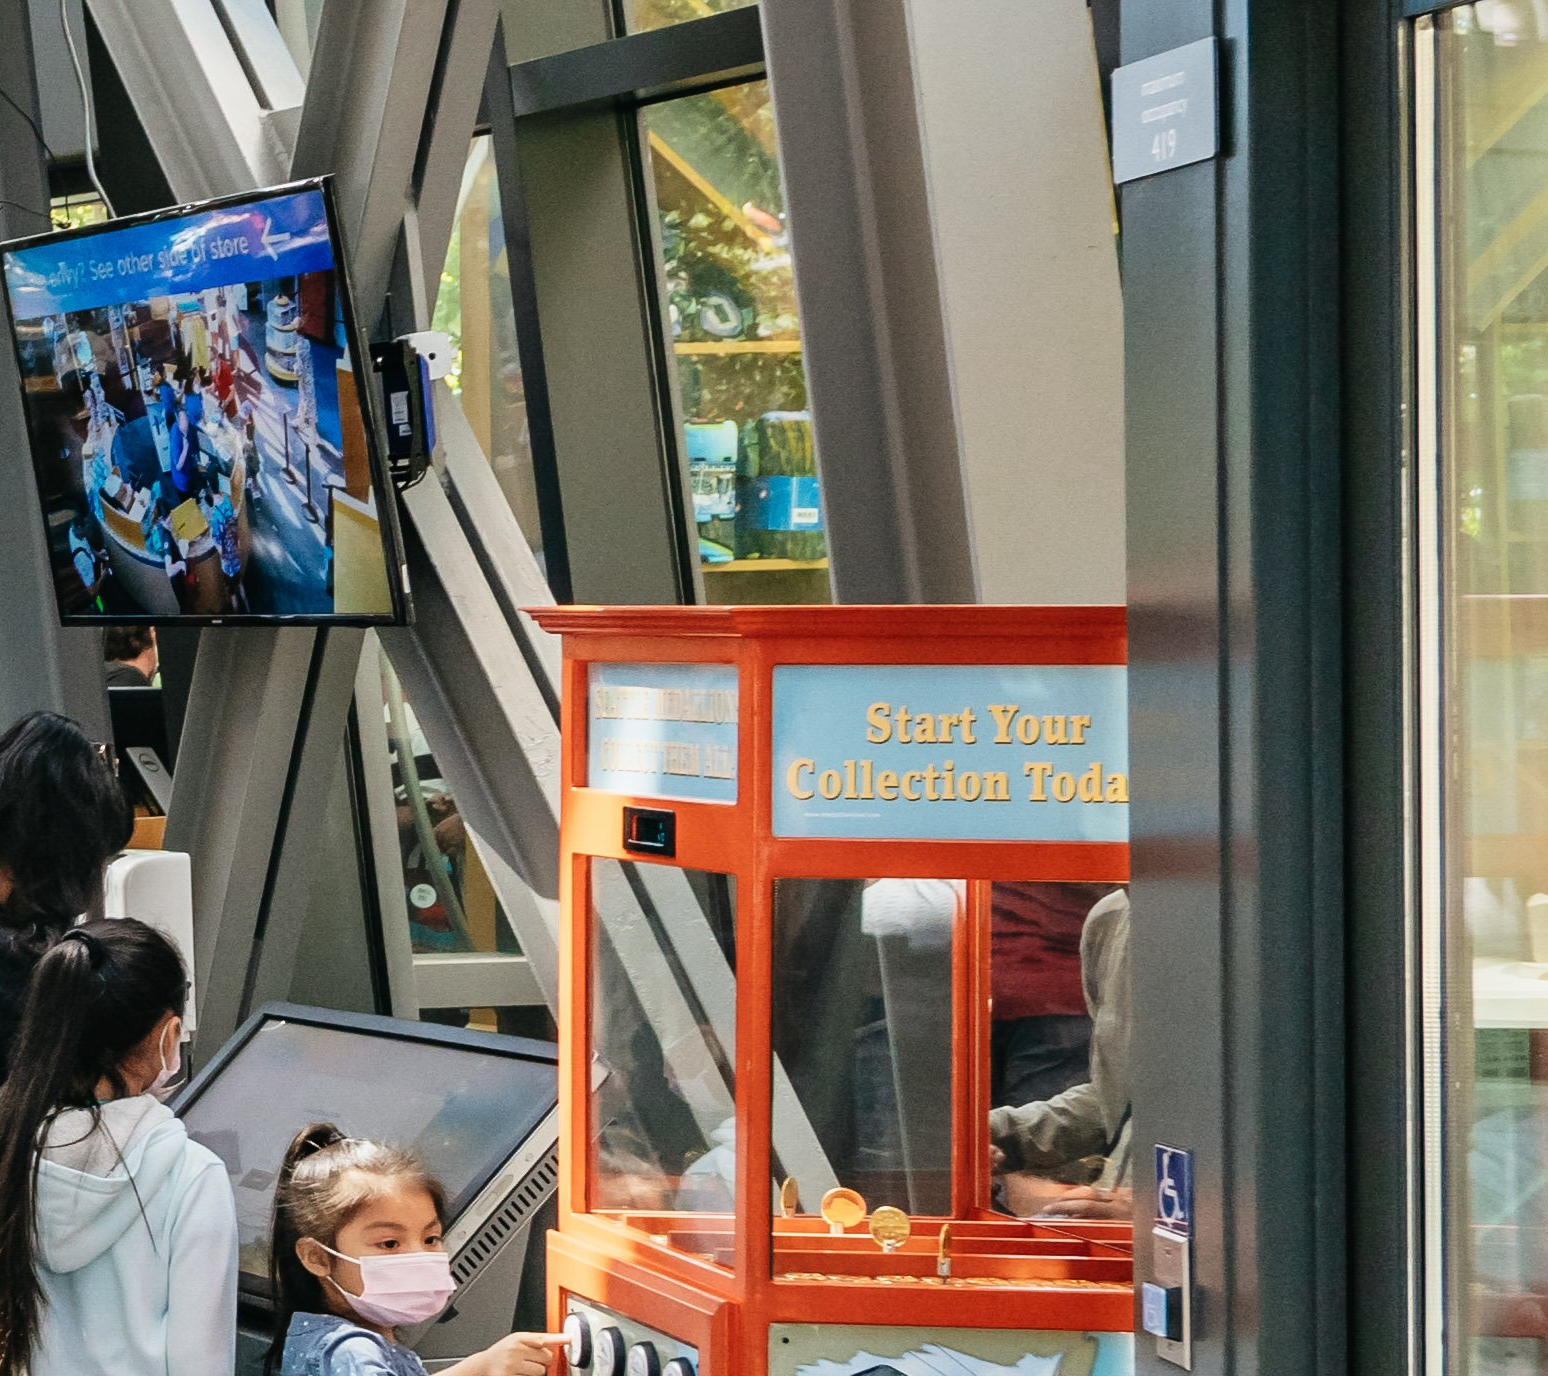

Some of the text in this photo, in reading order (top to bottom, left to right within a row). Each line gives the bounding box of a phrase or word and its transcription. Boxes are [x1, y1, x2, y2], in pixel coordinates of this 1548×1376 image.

[89, 259, 113, 281] See
[117, 251, 154, 276] other
[191, 240, 207, 264] of
[210, 234, 250, 259] store
[866, 702, 1092, 745] Start Your
[786, 758, 1129, 803] Collection Toda
